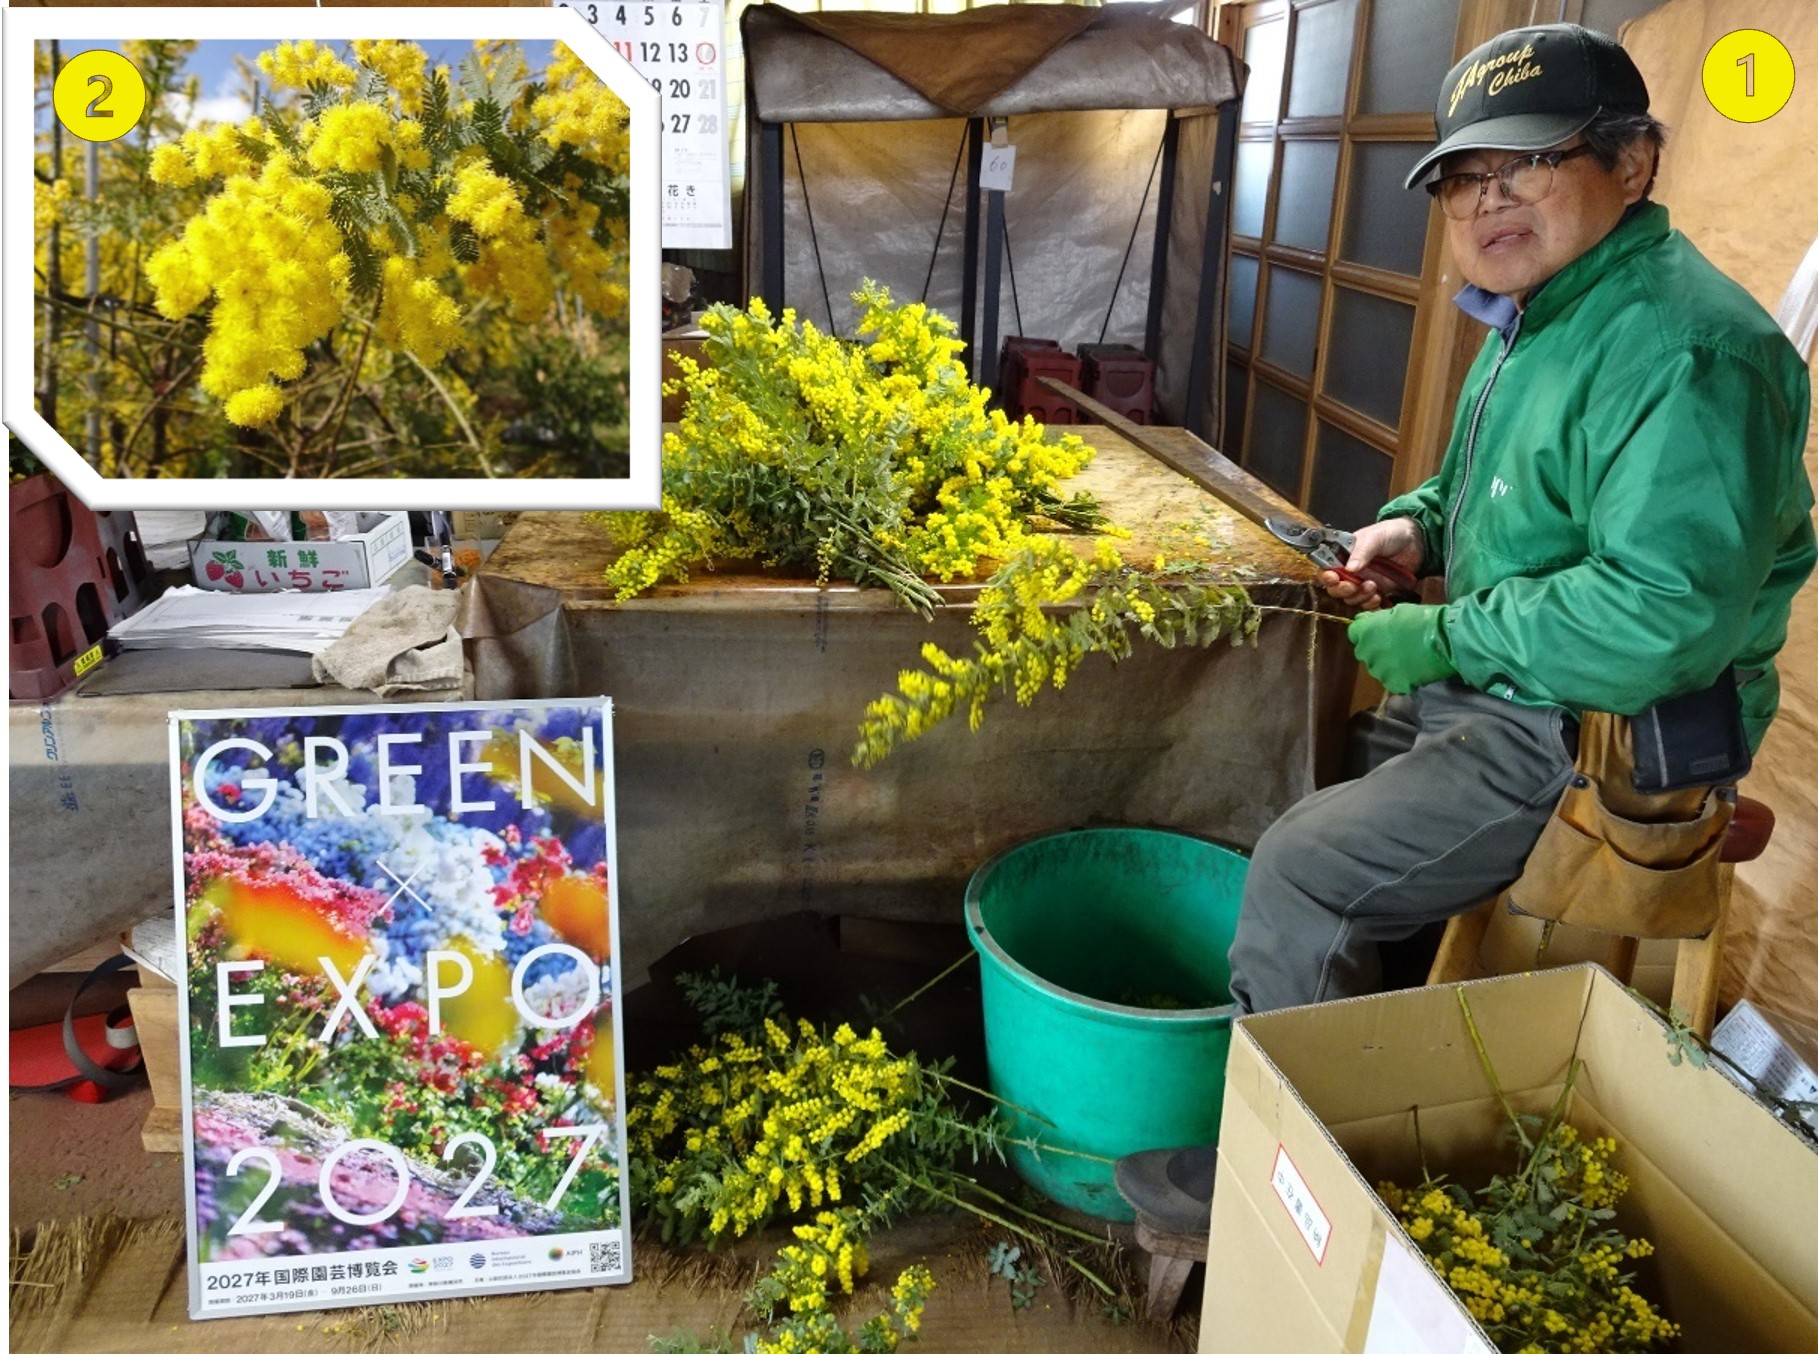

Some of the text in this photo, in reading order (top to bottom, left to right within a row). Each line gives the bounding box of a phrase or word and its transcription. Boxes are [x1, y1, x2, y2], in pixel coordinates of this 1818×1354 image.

[587, 5, 599, 25] 3
[616, 6, 627, 25] 4
[644, 6, 655, 26] 5
[672, 6, 683, 26] 6
[640, 43, 661, 62] 12
[669, 43, 688, 63] 13
[669, 79, 690, 98] 20
[1488, 61, 1544, 96] Chiba
[671, 114, 691, 134] 27
[266, 549, 320, 569] 新鮮
[254, 569, 349, 589] いちご
[193, 726, 597, 823] GREEN
[217, 943, 601, 1048] EXPO
[226, 1125, 601, 1236] 2027
[207, 1260, 398, 1291] 2027年国際園芸博覧会
